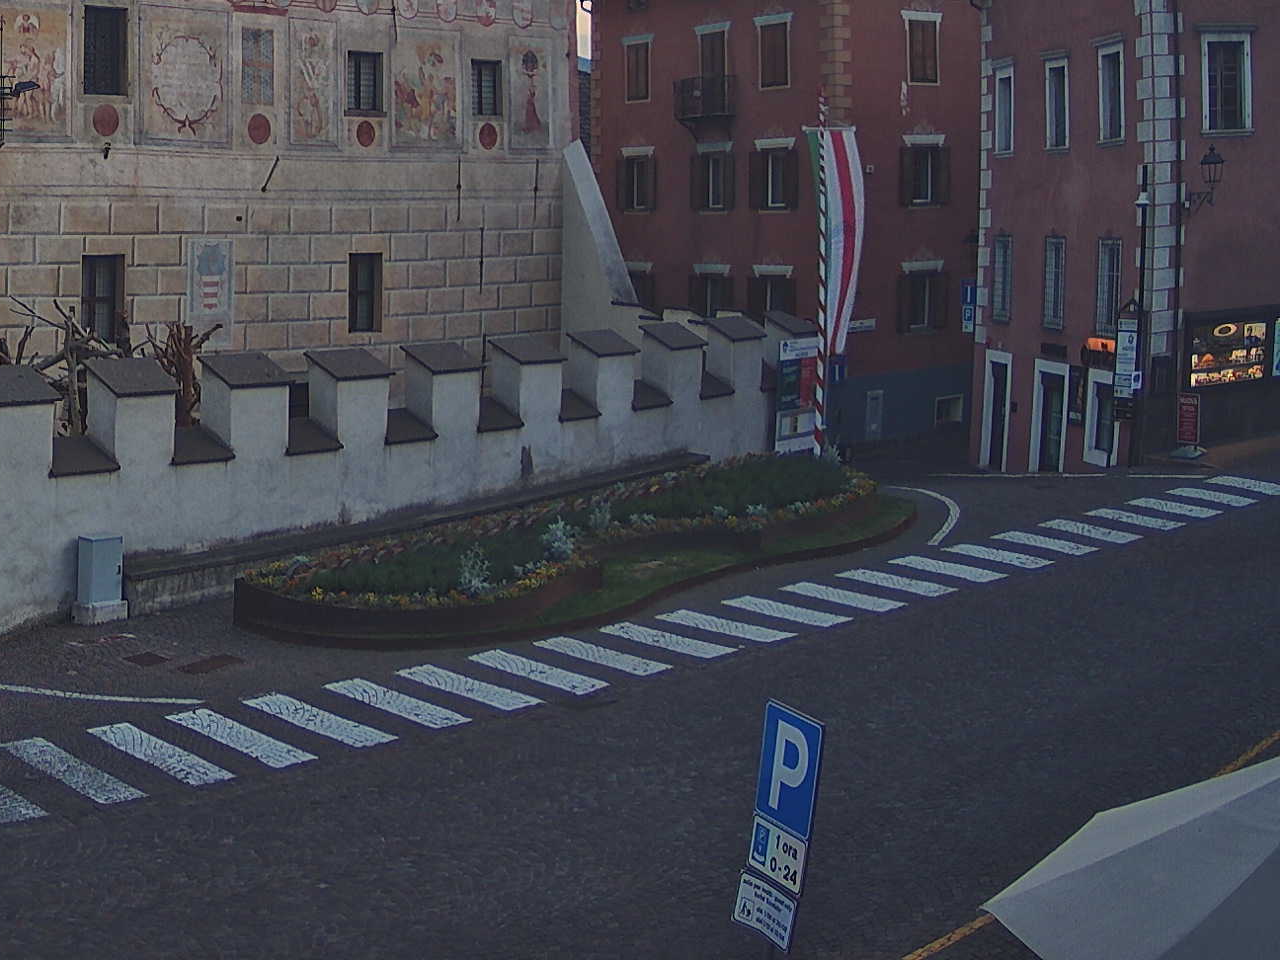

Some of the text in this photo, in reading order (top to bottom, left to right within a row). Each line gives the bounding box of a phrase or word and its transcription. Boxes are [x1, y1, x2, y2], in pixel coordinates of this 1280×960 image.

[965, 309, 971, 321] P
[768, 720, 809, 810] P
[775, 834, 798, 861] 1 ora
[770, 857, 797, 885] 0-24
